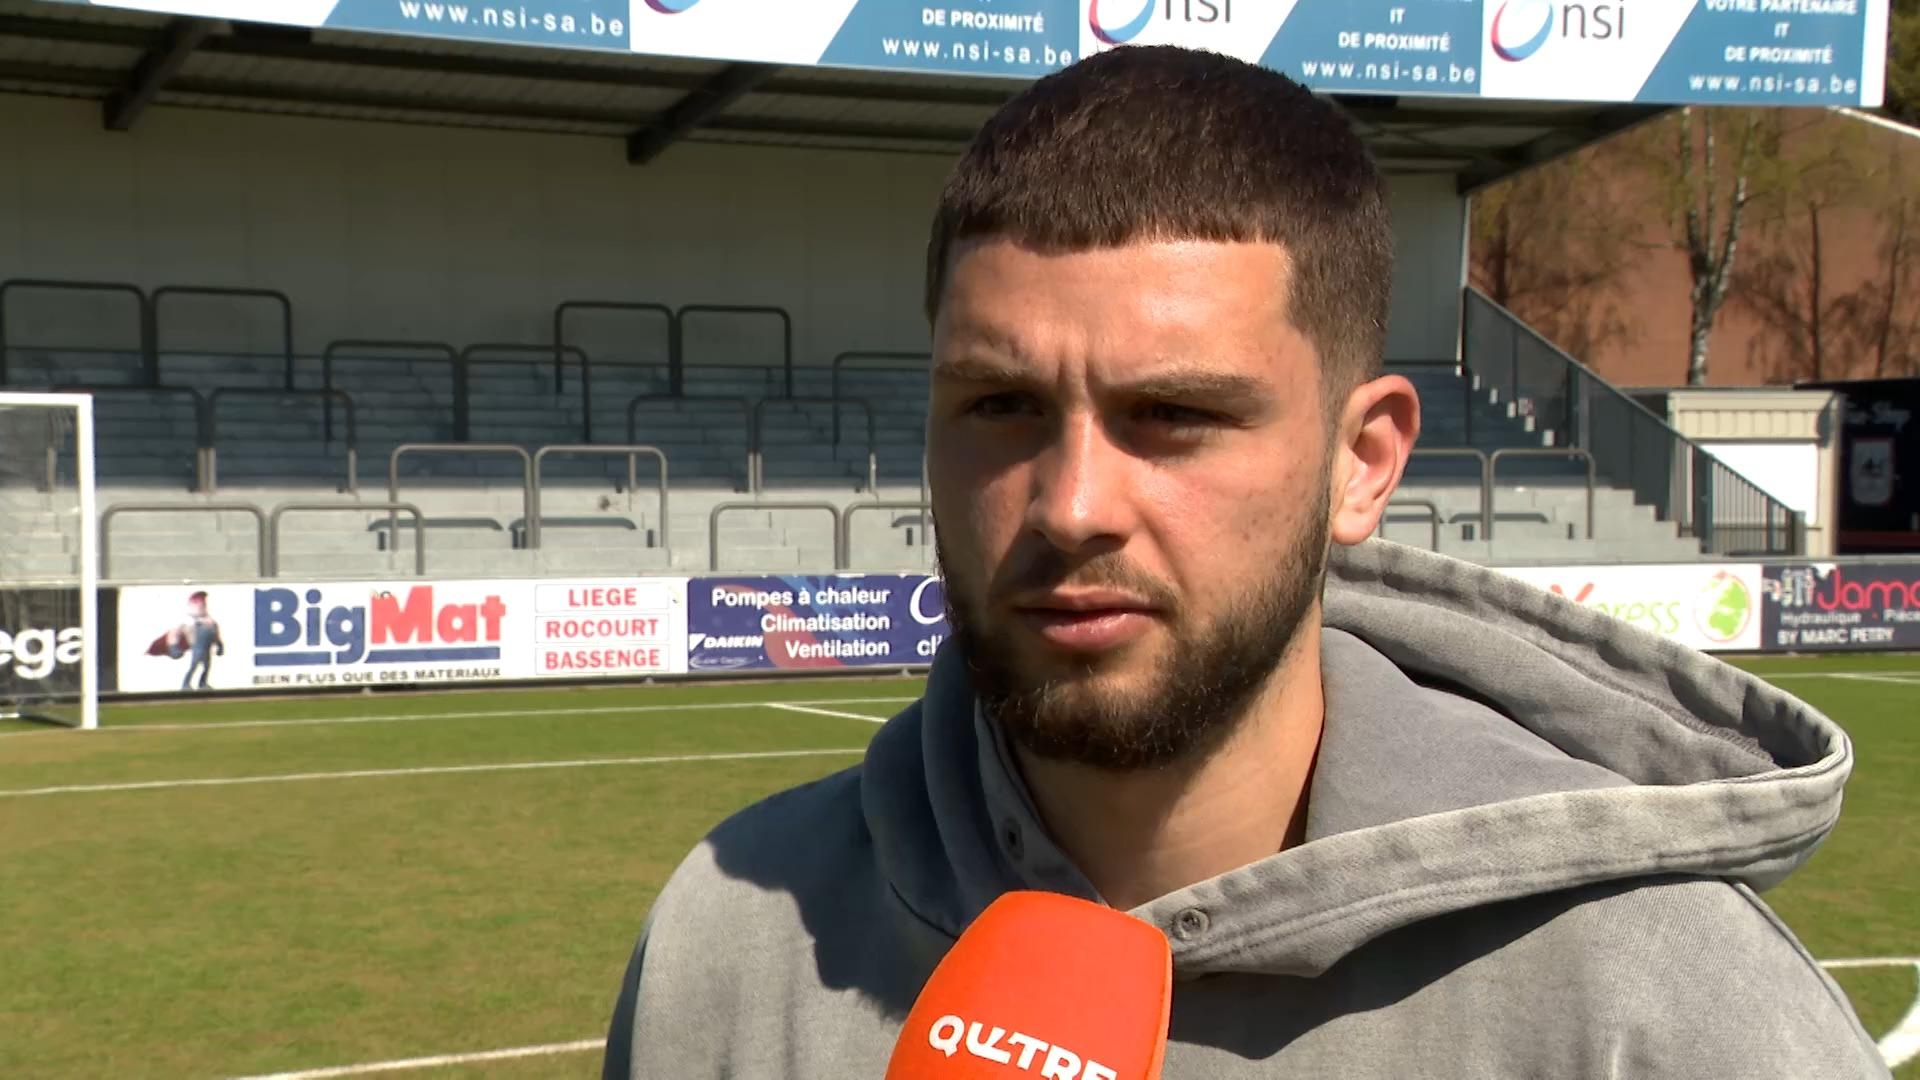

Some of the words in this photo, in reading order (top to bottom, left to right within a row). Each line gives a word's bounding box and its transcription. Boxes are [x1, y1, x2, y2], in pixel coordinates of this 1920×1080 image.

[400, 0, 624, 36] www.nsi-sa.be
[922, 8, 946, 26] DE
[951, 11, 1044, 33] PROXIMITÉ
[1390, 8, 1405, 24] IT
[1561, 0, 1625, 39] nsi
[1774, 22, 1790, 38] IT
[882, 37, 1072, 66] www.nsi-sa.be
[1338, 31, 1360, 48] DE
[1364, 32, 1450, 52] PROXIMITÉ
[1724, 45, 1746, 62] DE
[1750, 44, 1833, 64] PROXIMITÉ
[1302, 60, 1476, 83] www.nsi-sa.be
[1689, 73, 1857, 94] www.nsi-sa.be
[568, 588, 637, 607] LIEGE
[711, 588, 793, 610] Pompes
[798, 587, 811, 605] à
[815, 586, 891, 605] chaleur
[254, 585, 506, 664] BigMat
[546, 619, 658, 638] ROCOURT
[760, 613, 890, 633] Climatisation
[704, 635, 763, 649] DAIKIN
[1778, 630, 1798, 645] BY
[1801, 629, 1848, 644] MARC
[785, 639, 890, 659] Ventilation
[545, 649, 660, 670] BASSENGE
[252, 674, 290, 685] BIEN
[296, 672, 336, 683] PLUS
[342, 671, 373, 682] QUE
[379, 670, 409, 681] DES
[414, 667, 501, 680] MATERIAUX
